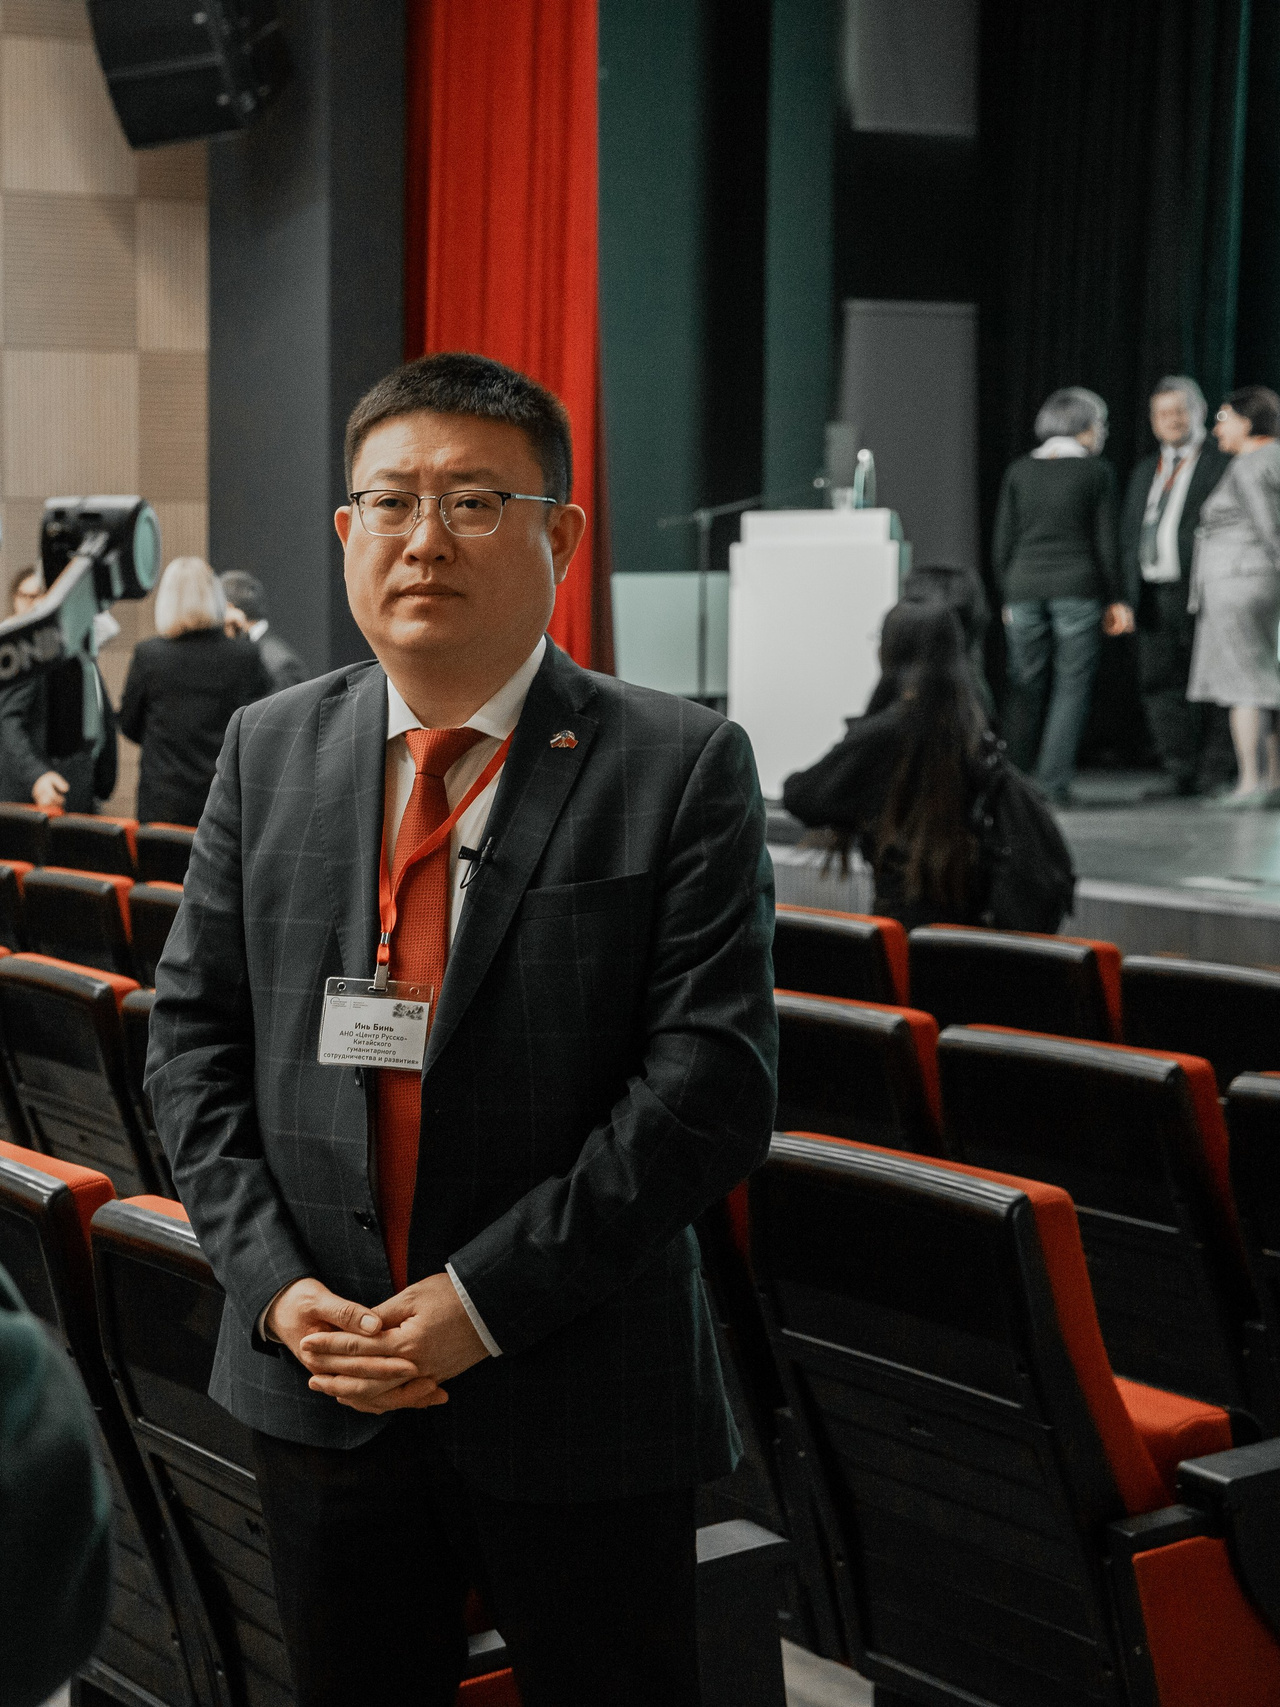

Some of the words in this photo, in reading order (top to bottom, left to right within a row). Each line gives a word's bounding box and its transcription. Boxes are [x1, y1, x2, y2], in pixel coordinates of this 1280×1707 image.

[354, 1022, 371, 1031] Инь
[373, 1023, 394, 1032] Бинь
[353, 1039, 392, 1048] Китайского
[346, 1046, 397, 1056] гуманитарного
[323, 1052, 377, 1061] сотрудничества
